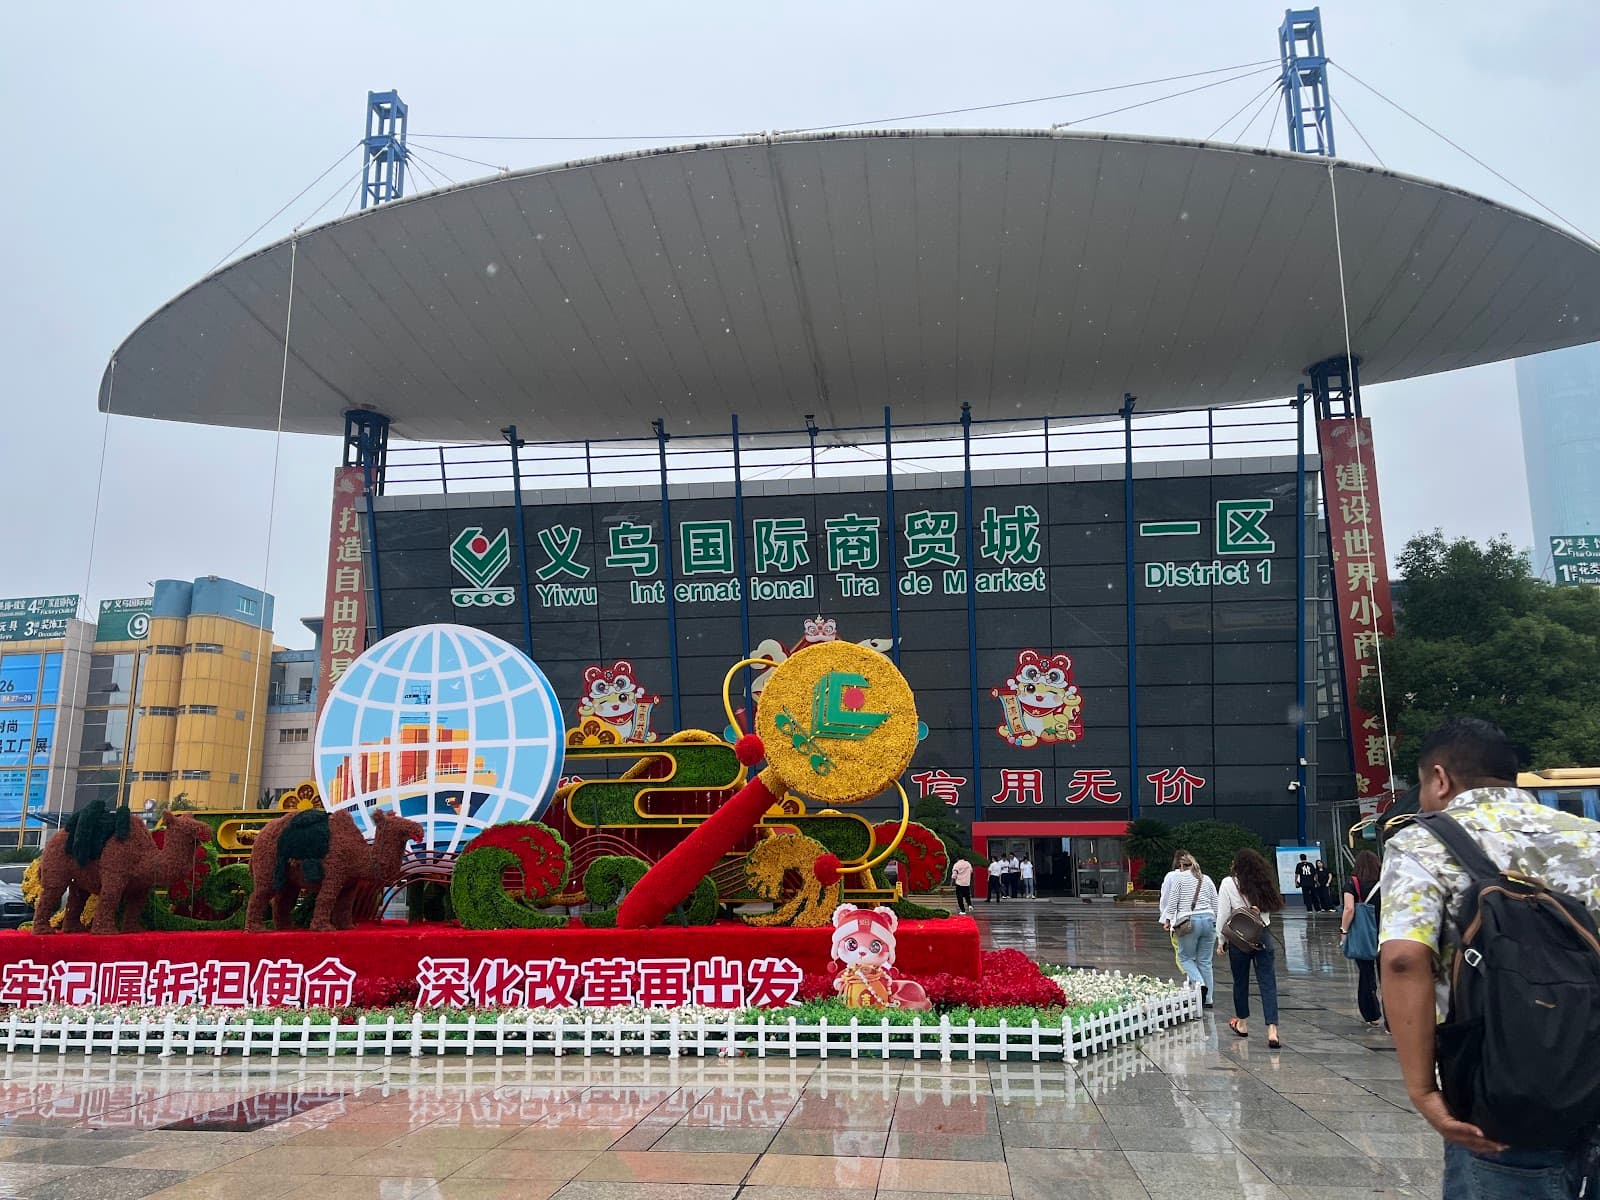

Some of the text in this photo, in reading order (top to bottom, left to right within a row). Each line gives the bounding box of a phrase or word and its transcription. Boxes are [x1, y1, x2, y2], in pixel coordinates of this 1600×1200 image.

[535, 499, 1275, 581] 义乌国际商贸城 一区
[1552, 538, 1567, 556] 2
[535, 584, 598, 608] Yiwu
[1145, 560, 1250, 588] District
[1257, 559, 1272, 585] 1
[1559, 564, 1570, 582] 1
[28, 599, 37, 614] 4
[329, 507, 362, 694] 打造自由贸易
[1335, 462, 1396, 767] 建设世界小商都
[24, 621, 34, 637] 3
[134, 617, 148, 635] 9
[0, 738, 48, 753] 工厂展
[910, 766, 1206, 806] 信用无价
[2, 957, 357, 1009] 牢记嘱托担使命
[416, 956, 802, 1009] 深化改革再出发
